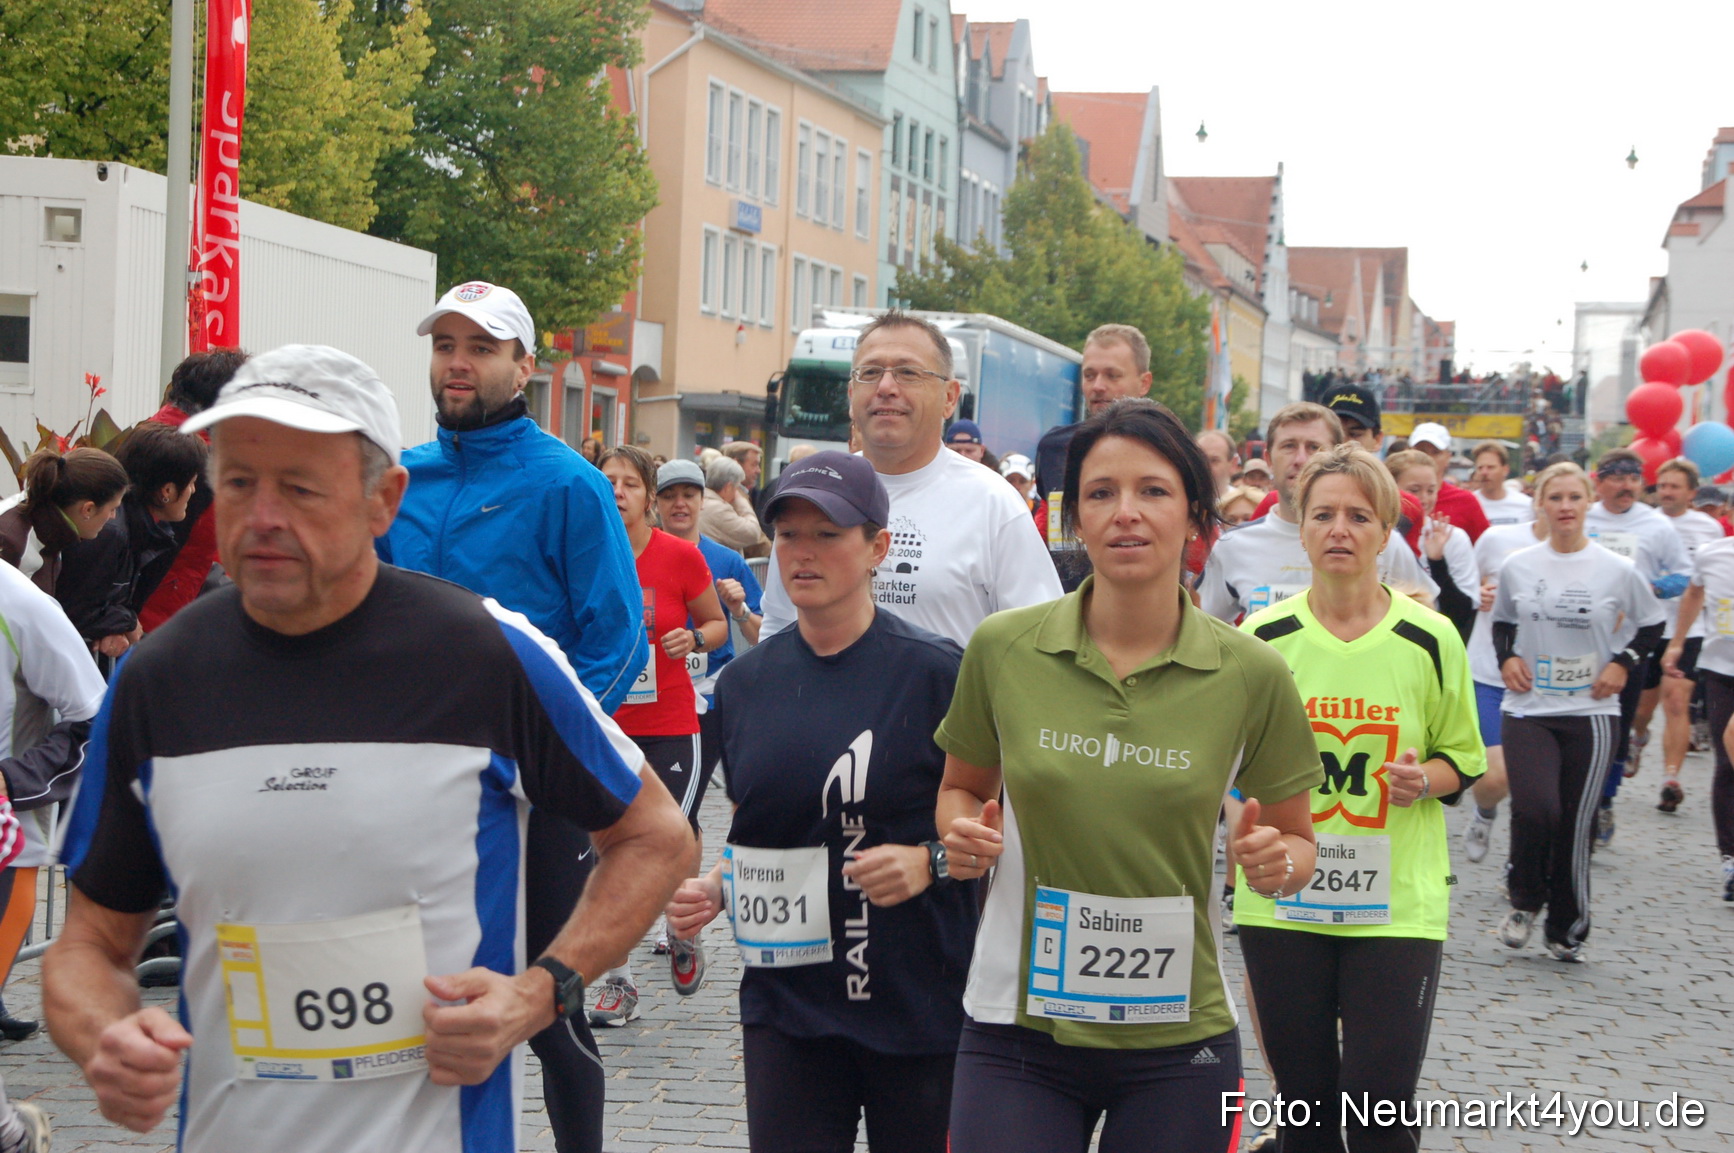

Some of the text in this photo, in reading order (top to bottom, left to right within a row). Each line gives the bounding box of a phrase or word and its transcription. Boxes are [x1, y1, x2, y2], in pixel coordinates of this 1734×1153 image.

[200, 90, 240, 351] Sparkas
[1556, 667, 1592, 681] 2244
[1039, 728, 1192, 770] EURO POLES
[258, 776, 328, 792] Selection
[1318, 751, 1370, 796] M
[736, 859, 785, 882] Verena
[1310, 869, 1379, 893] 2647
[739, 894, 808, 925] 3031
[1079, 906, 1143, 933] Sabine
[1345, 910, 1389, 919] PFLEIDERER
[1043, 937, 1053, 954] C
[1078, 945, 1175, 979] 2227
[294, 981, 393, 1032] 698
[1043, 1002, 1186, 1015] BOCK PFLEIDERER
[355, 1044, 428, 1069] PFLEIDERE
[1190, 1057, 1221, 1065] adidas
